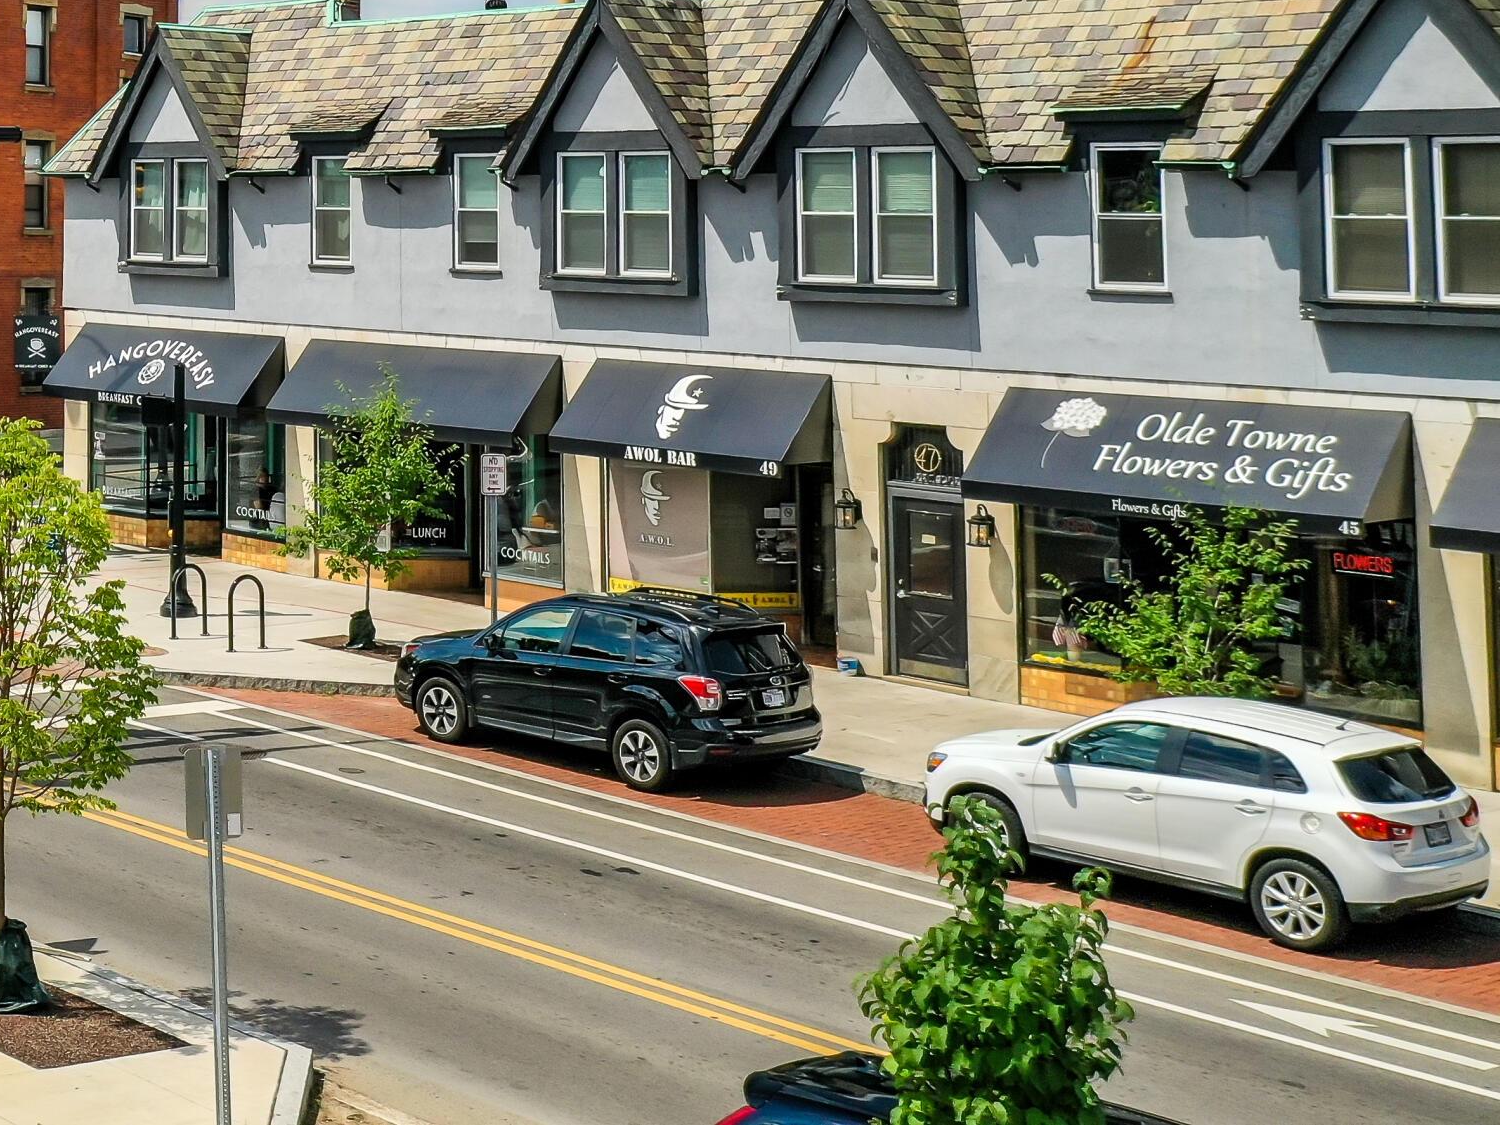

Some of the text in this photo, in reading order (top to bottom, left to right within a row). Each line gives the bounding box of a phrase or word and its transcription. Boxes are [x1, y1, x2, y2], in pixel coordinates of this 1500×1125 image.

[87, 339, 215, 390] HANGOVEREASY
[97, 391, 133, 405] BREAKFAST
[1136, 411, 1338, 454] Olde Towne
[488, 457, 499, 466] NO
[623, 445, 697, 467] AWOL BAR
[915, 444, 937, 471] 47
[759, 460, 779, 476] 49
[1092, 441, 1353, 500] Flowers & Gifts
[168, 491, 200, 502] LCH
[235, 504, 276, 522] COCKTAILS
[1111, 498, 1187, 521] Flowers & Gifts
[412, 526, 446, 540] LUNCH
[1338, 520, 1360, 536] 45
[639, 532, 675, 548] A.W.O.L.
[500, 545, 551, 566] COCKTAILS
[1333, 551, 1393, 574] FLOWERS
